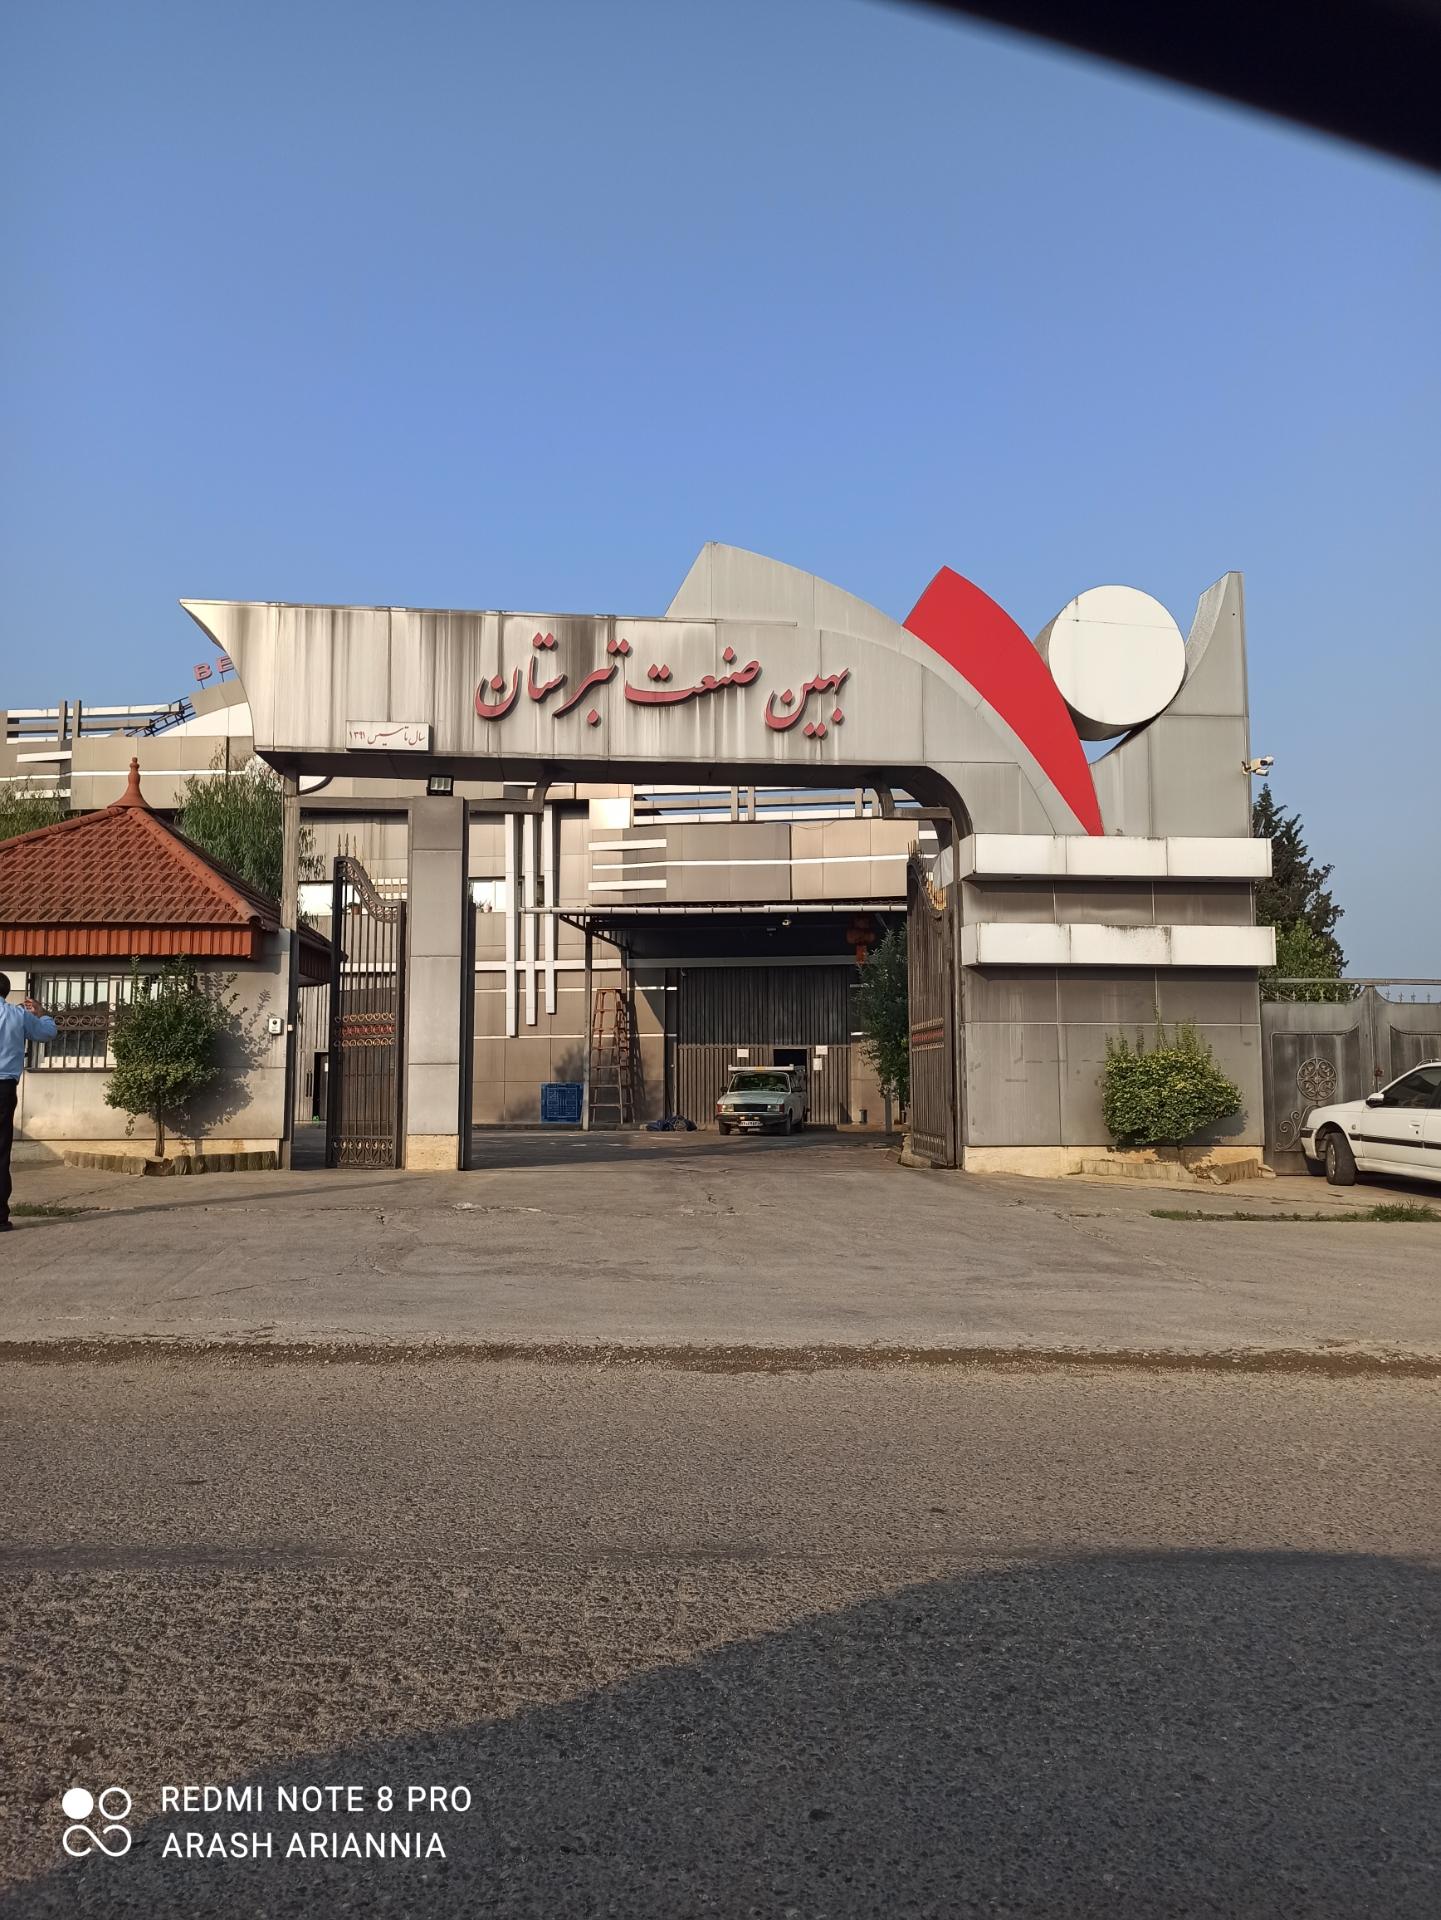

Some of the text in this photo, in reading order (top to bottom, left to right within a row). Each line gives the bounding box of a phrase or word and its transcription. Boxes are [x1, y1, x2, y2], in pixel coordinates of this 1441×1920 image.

[475, 632, 849, 738] بهین صنعت تبرستان
[408, 730, 425, 746] سال
